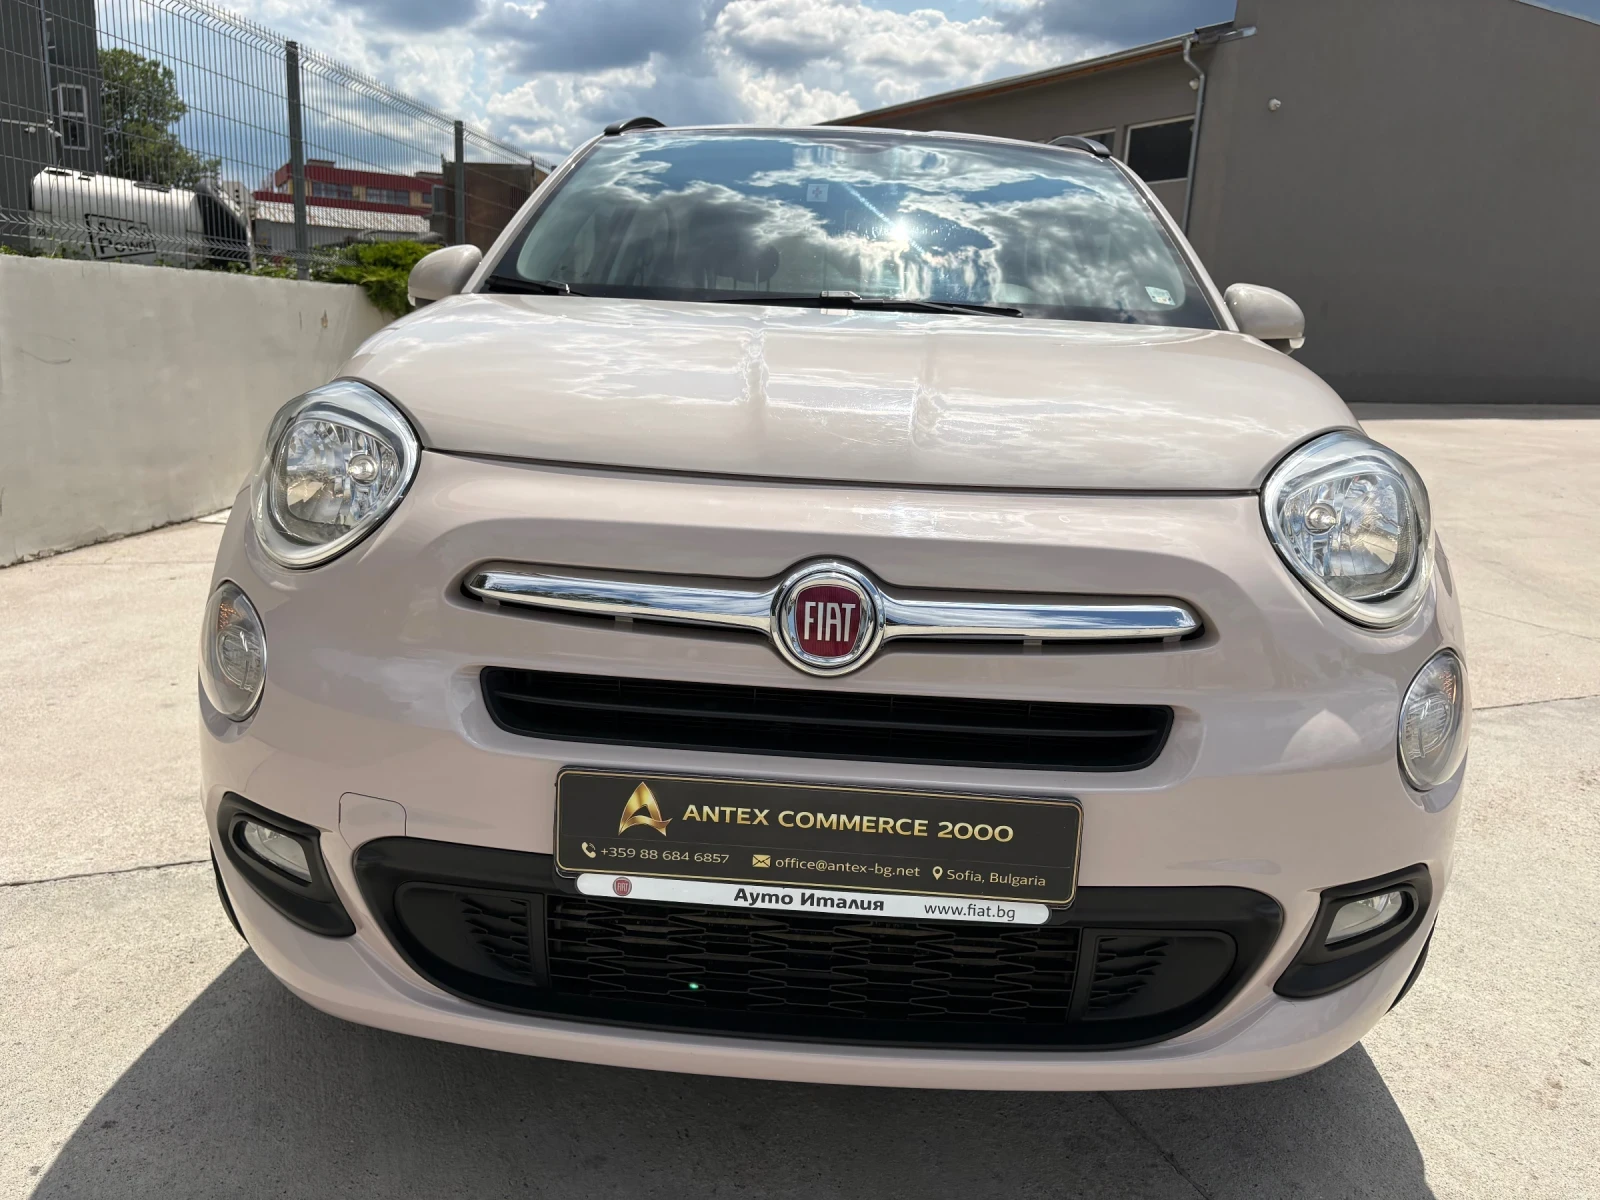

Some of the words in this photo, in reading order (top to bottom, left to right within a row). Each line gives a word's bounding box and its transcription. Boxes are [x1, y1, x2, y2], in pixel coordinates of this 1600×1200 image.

[803, 601, 857, 642] FIAT
[682, 804, 770, 826] ANTEX
[778, 810, 929, 837] COMMERCE
[937, 821, 1014, 843] 2000
[600, 847, 636, 859] +359
[640, 849, 658, 860] 88
[662, 850, 690, 862] 684
[694, 852, 730, 864] 6857
[775, 857, 920, 878] office@antex-bg.net
[946, 868, 985, 884] Sofia,
[989, 872, 1046, 887] Bulgaria
[733, 888, 794, 906] Ауто
[800, 892, 885, 911] Италия
[924, 903, 1016, 921] www.fiat.bg
